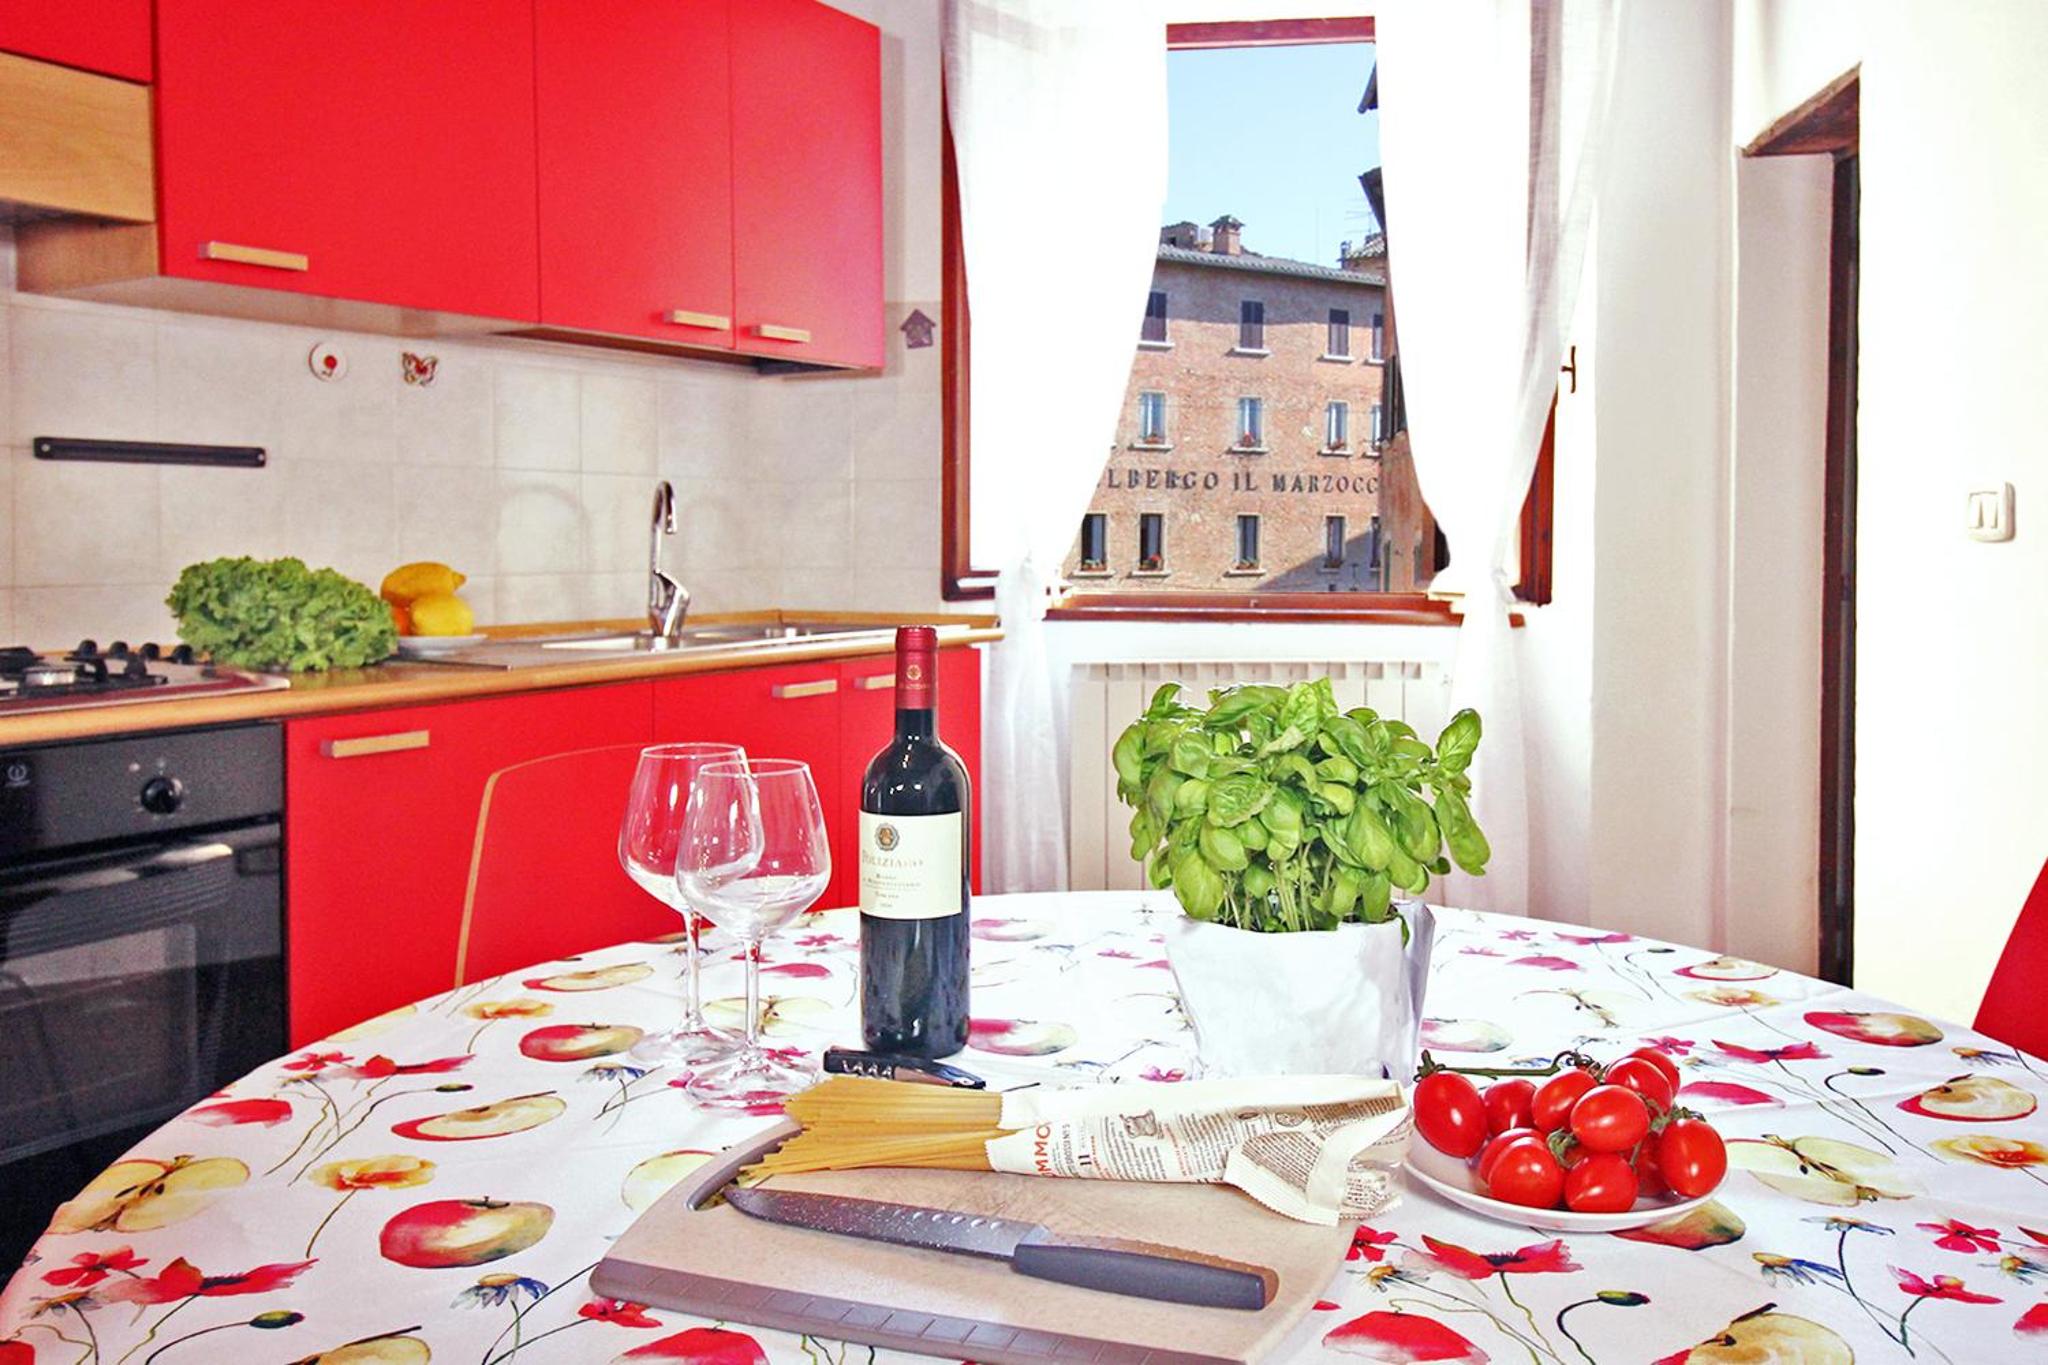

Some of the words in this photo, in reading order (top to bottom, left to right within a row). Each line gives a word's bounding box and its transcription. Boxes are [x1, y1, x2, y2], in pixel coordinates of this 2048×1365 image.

[1098, 469, 1219, 490] LBERGO
[1233, 471, 1258, 491] IL
[1272, 473, 1379, 494] MARZOCC
